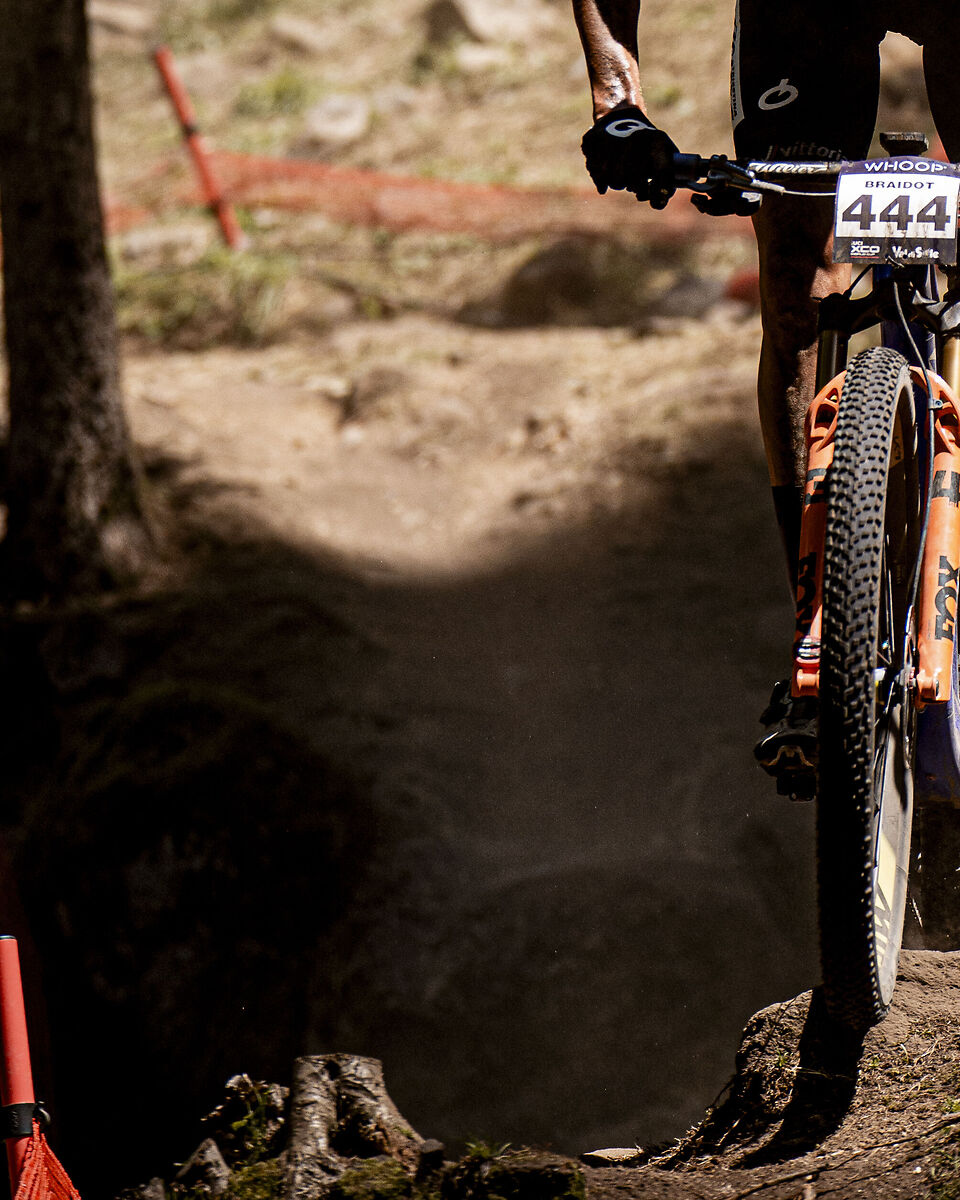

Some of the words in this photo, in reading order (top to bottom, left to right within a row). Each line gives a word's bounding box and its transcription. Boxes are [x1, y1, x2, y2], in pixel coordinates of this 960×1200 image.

[865, 160, 945, 173] WHOOP
[865, 180, 935, 190] BRAIDOT
[841, 194, 951, 232] 444
[850, 245, 880, 254] XCO
[934, 555, 960, 641] FOX
